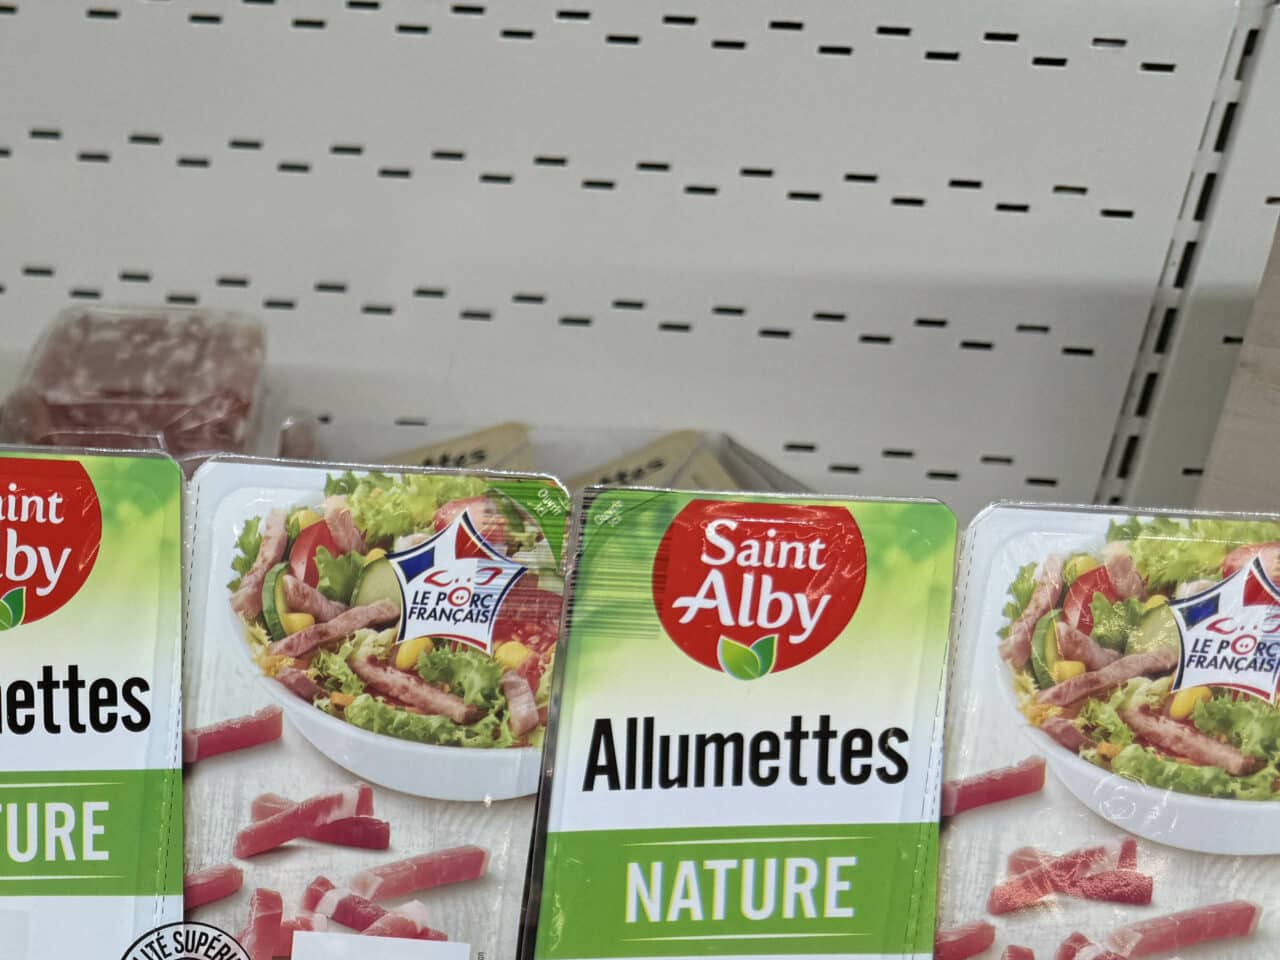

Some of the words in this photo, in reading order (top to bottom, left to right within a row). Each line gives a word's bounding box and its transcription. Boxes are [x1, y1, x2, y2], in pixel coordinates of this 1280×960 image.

[700, 518, 826, 570] Saint
[412, 591, 429, 605] LE
[435, 585, 495, 609] PORC
[672, 569, 831, 644] Alby
[408, 605, 491, 628] FRANÇAIS
[1186, 654, 1274, 674] FRANÇAIS
[1191, 638, 1210, 653] LE
[1216, 634, 1280, 657] PORC
[582, 715, 909, 792] Allumettes
[626, 856, 858, 923] NATURE
